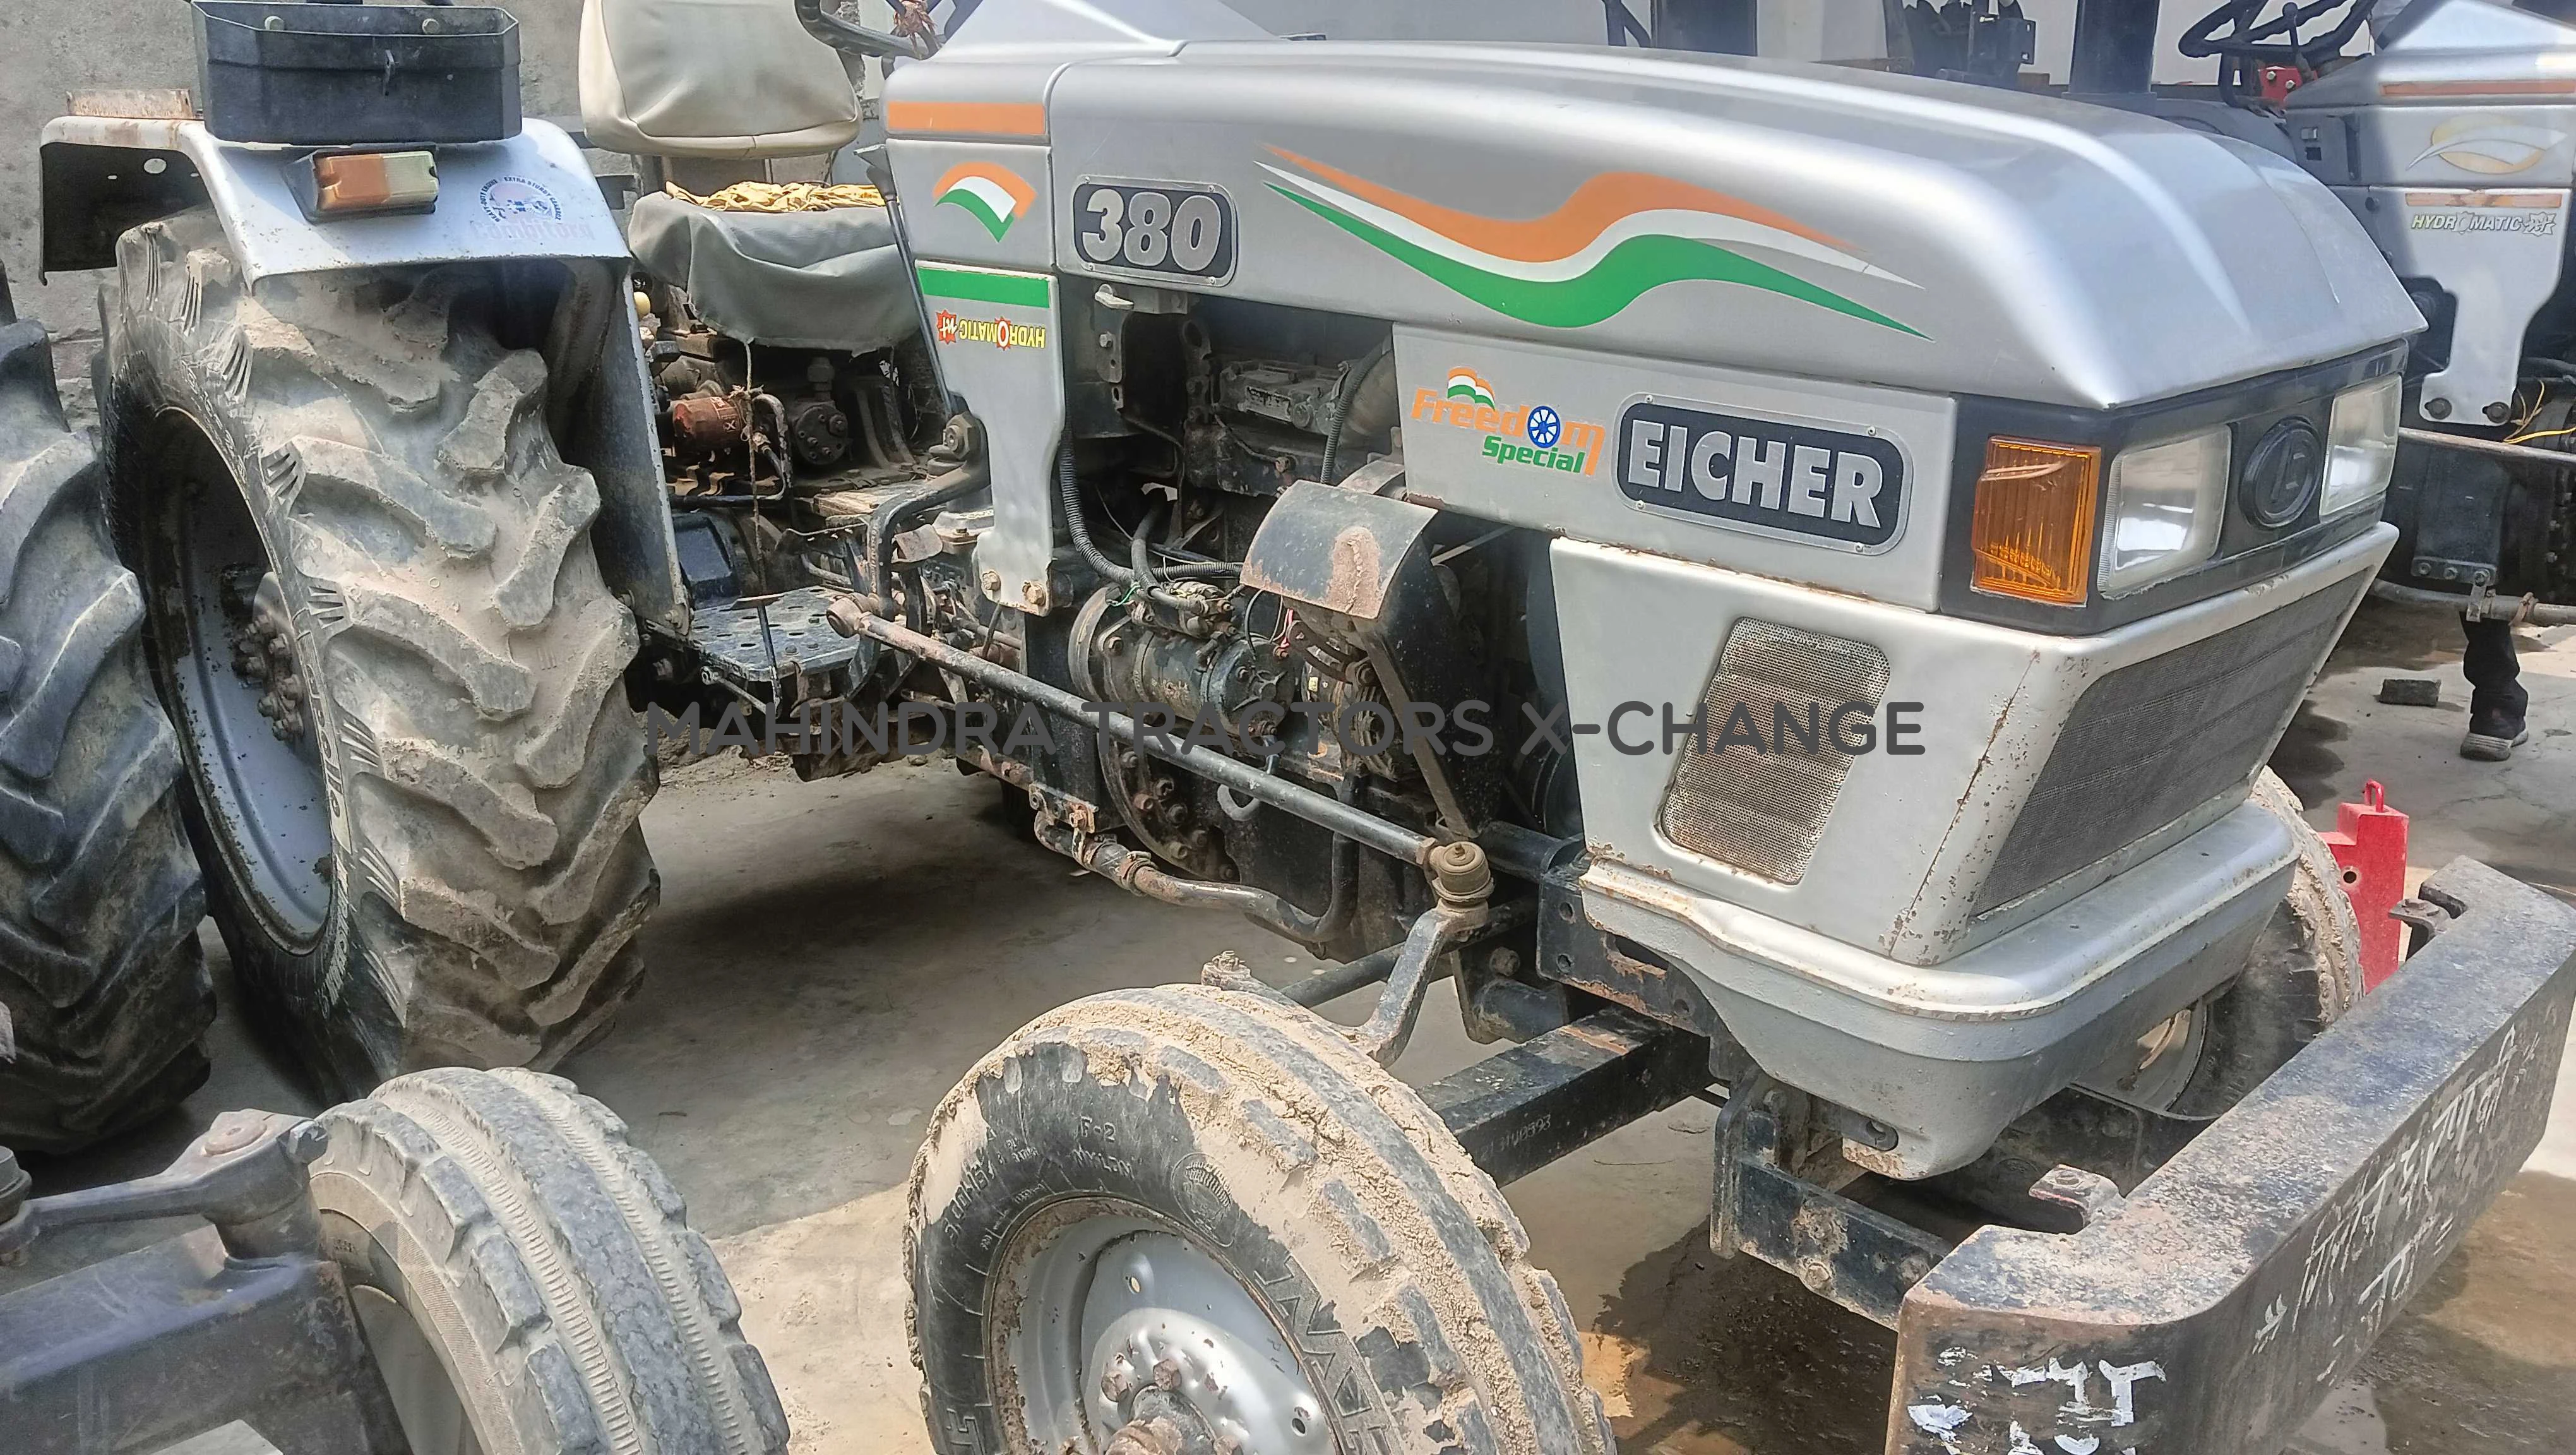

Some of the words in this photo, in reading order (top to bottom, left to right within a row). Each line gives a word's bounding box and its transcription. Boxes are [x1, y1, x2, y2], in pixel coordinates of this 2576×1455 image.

[1082, 188, 1222, 272] 380
[2411, 212, 2523, 234] HYDROMATIC
[958, 318, 1046, 349] HYDROMATIC
[1410, 386, 1606, 476] Freedom
[1482, 434, 1586, 474] Special
[1627, 419, 1884, 529] EICHER
[1080, 1115, 1116, 1141] F-2
